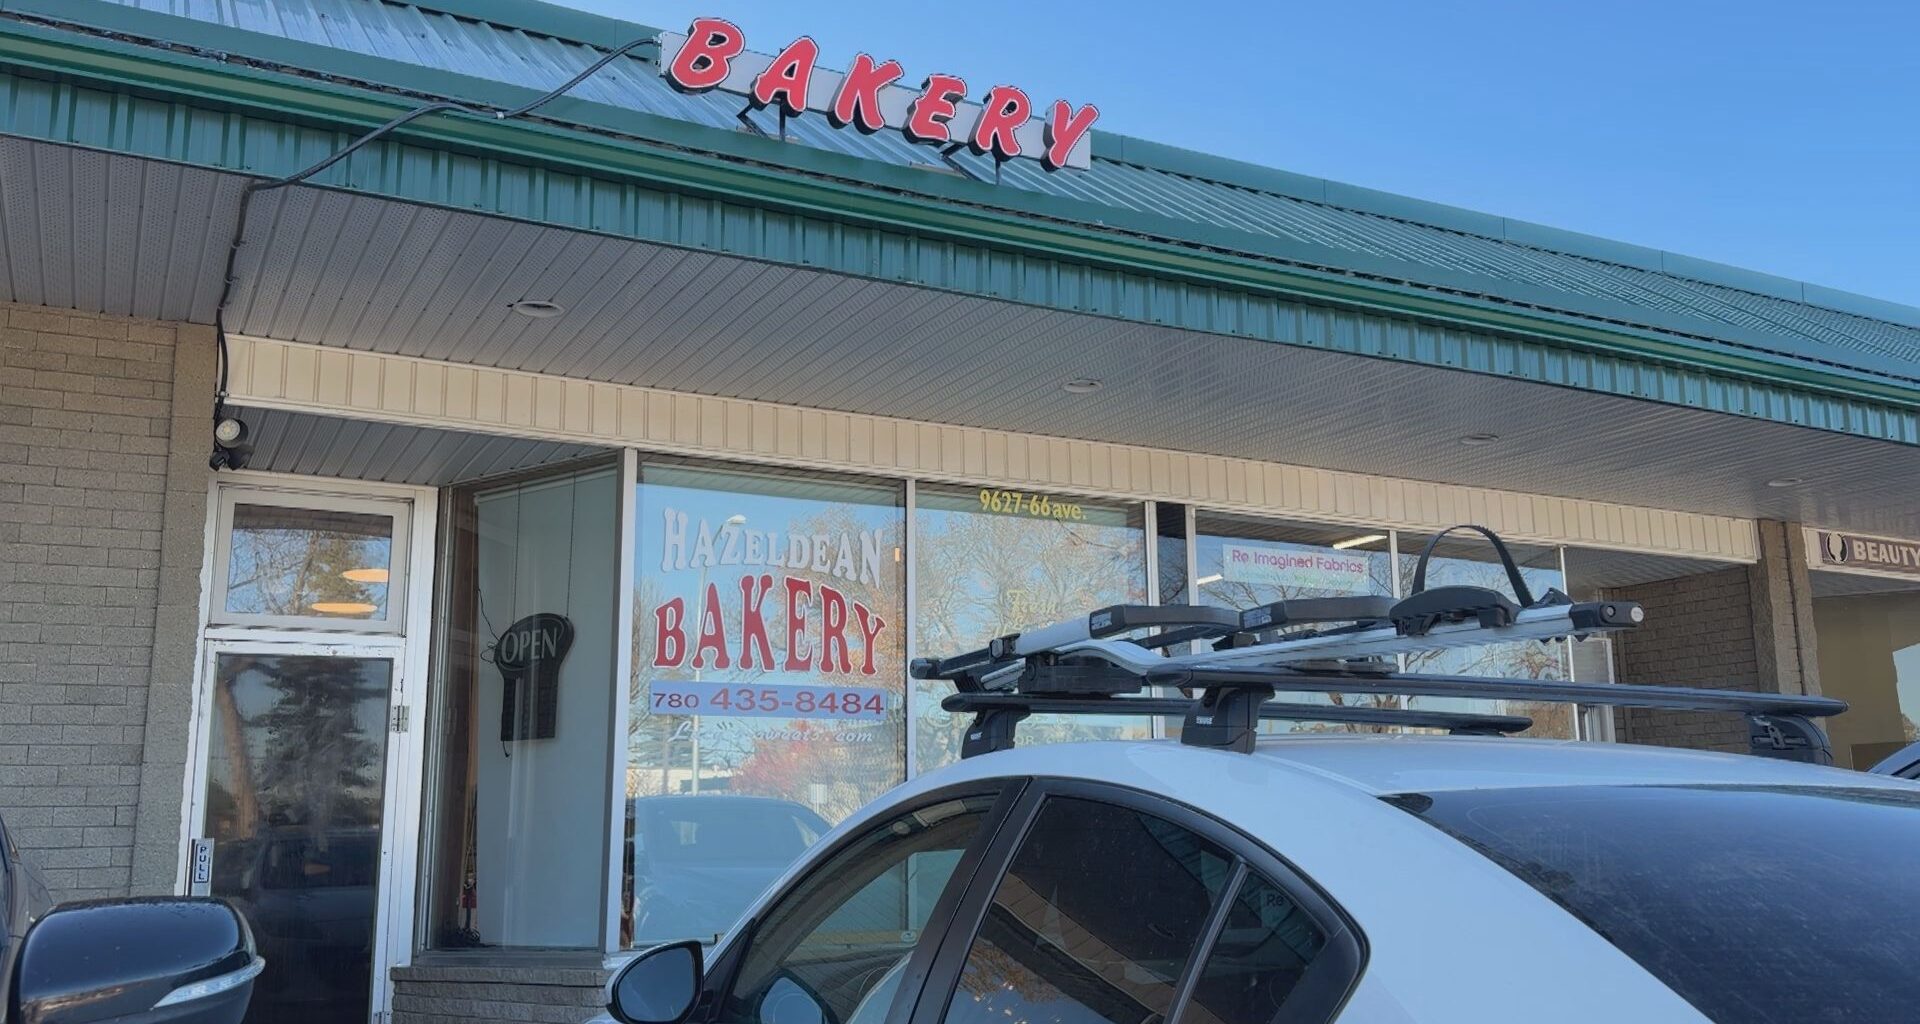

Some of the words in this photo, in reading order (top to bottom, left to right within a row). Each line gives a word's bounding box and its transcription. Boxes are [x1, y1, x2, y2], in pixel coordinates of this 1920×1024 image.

[667, 16, 1100, 172] BAKERY
[660, 507, 883, 590] HAZELDEAN
[1232, 549, 1249, 563] Re
[1254, 553, 1313, 570] Imagined
[1316, 558, 1364, 574] Fabrics
[1852, 539, 1920, 567] BEAUTY
[652, 573, 887, 676] BAKERY
[501, 627, 558, 664] OPEN
[652, 692, 699, 709] 780
[709, 687, 884, 715] 435-8484
[198, 846, 207, 880] PULL
